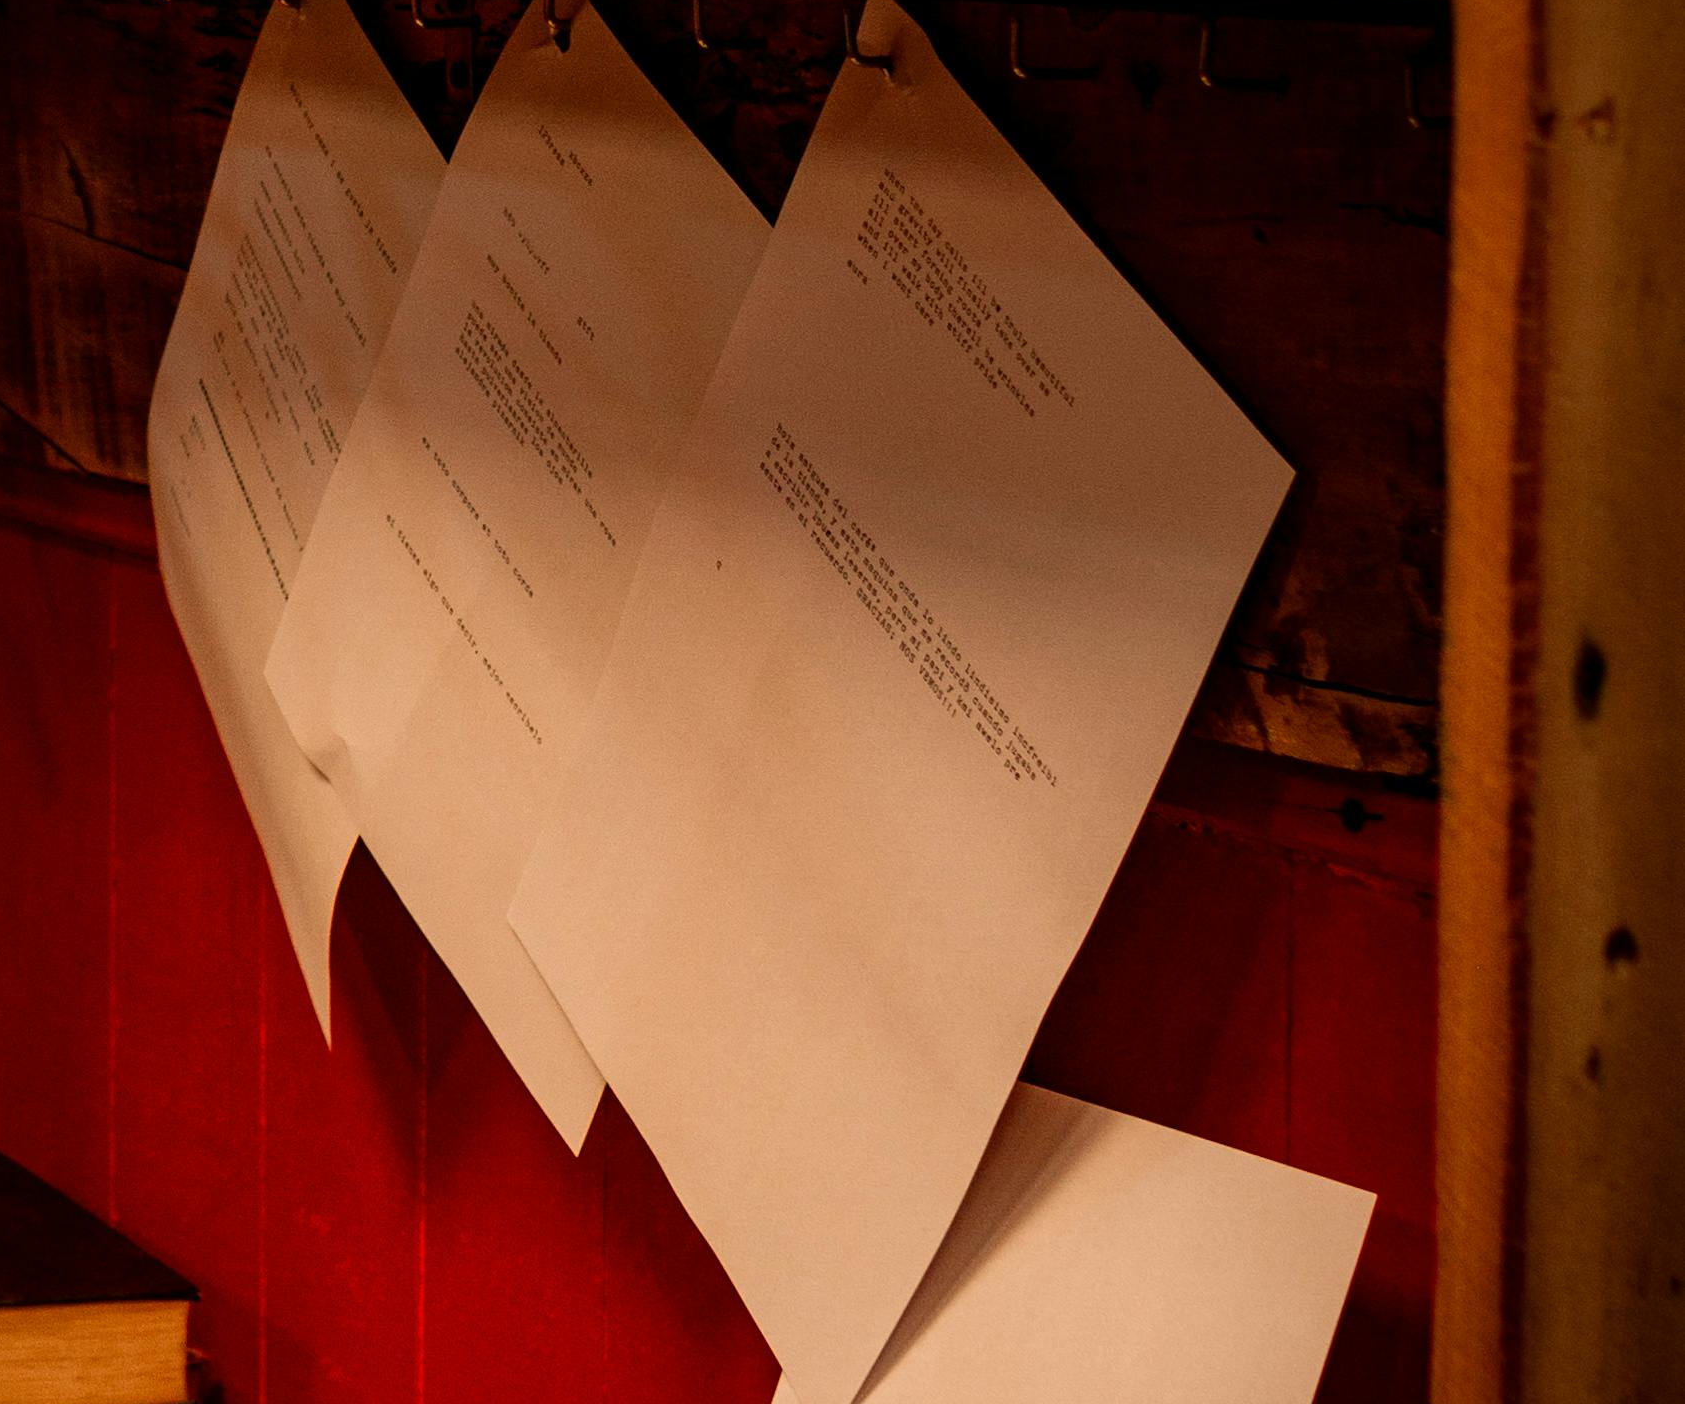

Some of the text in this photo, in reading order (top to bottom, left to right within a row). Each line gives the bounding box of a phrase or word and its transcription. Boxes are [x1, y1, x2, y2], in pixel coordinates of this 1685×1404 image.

[856, 228, 936, 330] when care
[861, 216, 1000, 391] and walk with stiff pride
[886, 226, 1037, 420] over my body wrinkles
[892, 213, 983, 331] start roots
[896, 201, 1051, 398] gravity will finally take over me
[758, 460, 917, 668] sente en mi recuerdo. NOS
[769, 433, 782, 453] de
[782, 449, 796, 470] la
[795, 467, 829, 517] tienda,
[838, 525, 861, 556] esta
[861, 552, 899, 605] maquina
[899, 601, 919, 629] que
[918, 625, 933, 648] me
[970, 691, 1005, 740] cuando
[1003, 734, 1039, 786] jugaba
[771, 457, 811, 513] escribir
[883, 602, 908, 637] pero
[907, 631, 923, 655] mi
[921, 649, 945, 684] papi
[1001, 755, 1023, 787] pre
[775, 420, 963, 665] hola del que onda lo lindo
